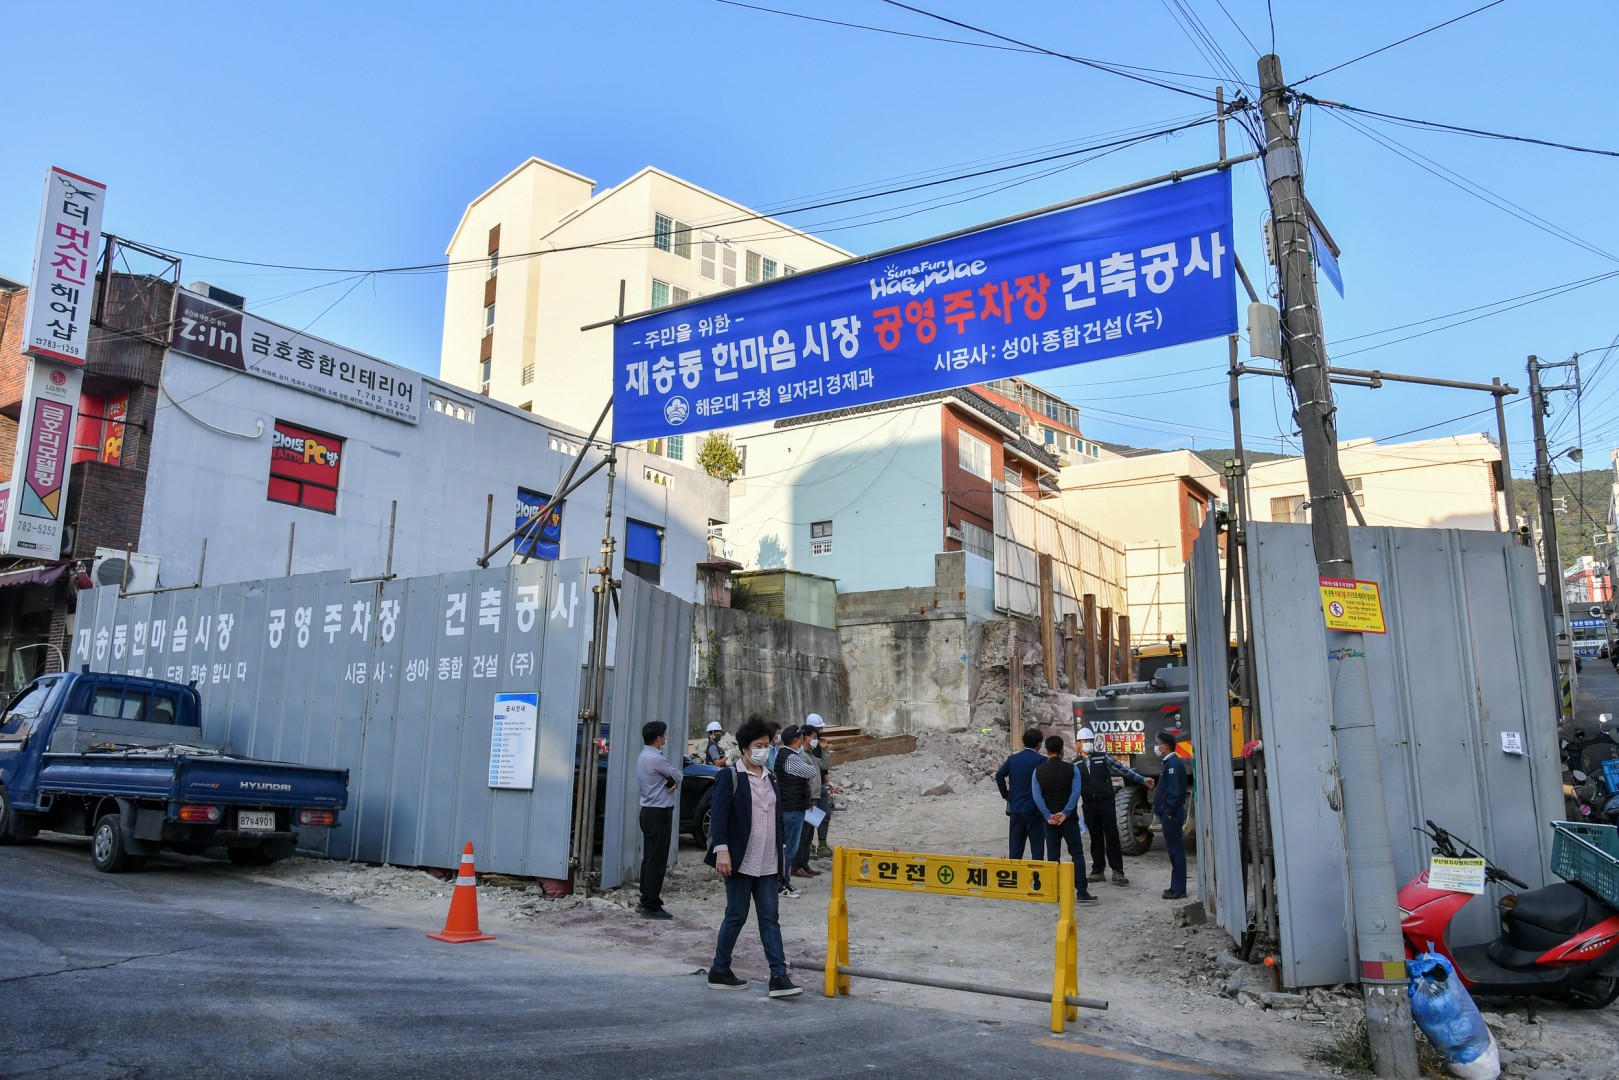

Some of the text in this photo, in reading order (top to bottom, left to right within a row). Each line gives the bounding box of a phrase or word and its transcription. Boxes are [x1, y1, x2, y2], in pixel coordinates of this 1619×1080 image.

[62, 200, 89, 227] 더
[50, 222, 90, 287] 멋진
[870, 259, 988, 300] Haeundae
[887, 260, 946, 281] Sun&Fun
[46, 282, 80, 342] 헤어샵
[625, 231, 1226, 396] 재송동 한마음 시장 공영 주차장 건축공사
[644, 322, 692, 349] 주민을
[698, 313, 731, 337] 위한
[43, 338, 79, 356] 783-1259
[250, 331, 413, 403] 금호종합인테리어
[356, 388, 411, 412] T.782.5252
[777, 377, 823, 404] 일자리
[826, 368, 874, 393] 경제과
[34, 404, 65, 487] 금호리모델링
[17, 520, 57, 537] 782-5252
[445, 581, 579, 637] 건축공사
[405, 658, 430, 682] 성아
[510, 651, 534, 677] (주)
[505, 705, 526, 713] 공사안내
[1090, 720, 1145, 732] VOLVO
[1106, 741, 1142, 752] 접근금지
[239, 781, 291, 791] HYUNDAI
[877, 861, 1018, 889] 안전 제일
